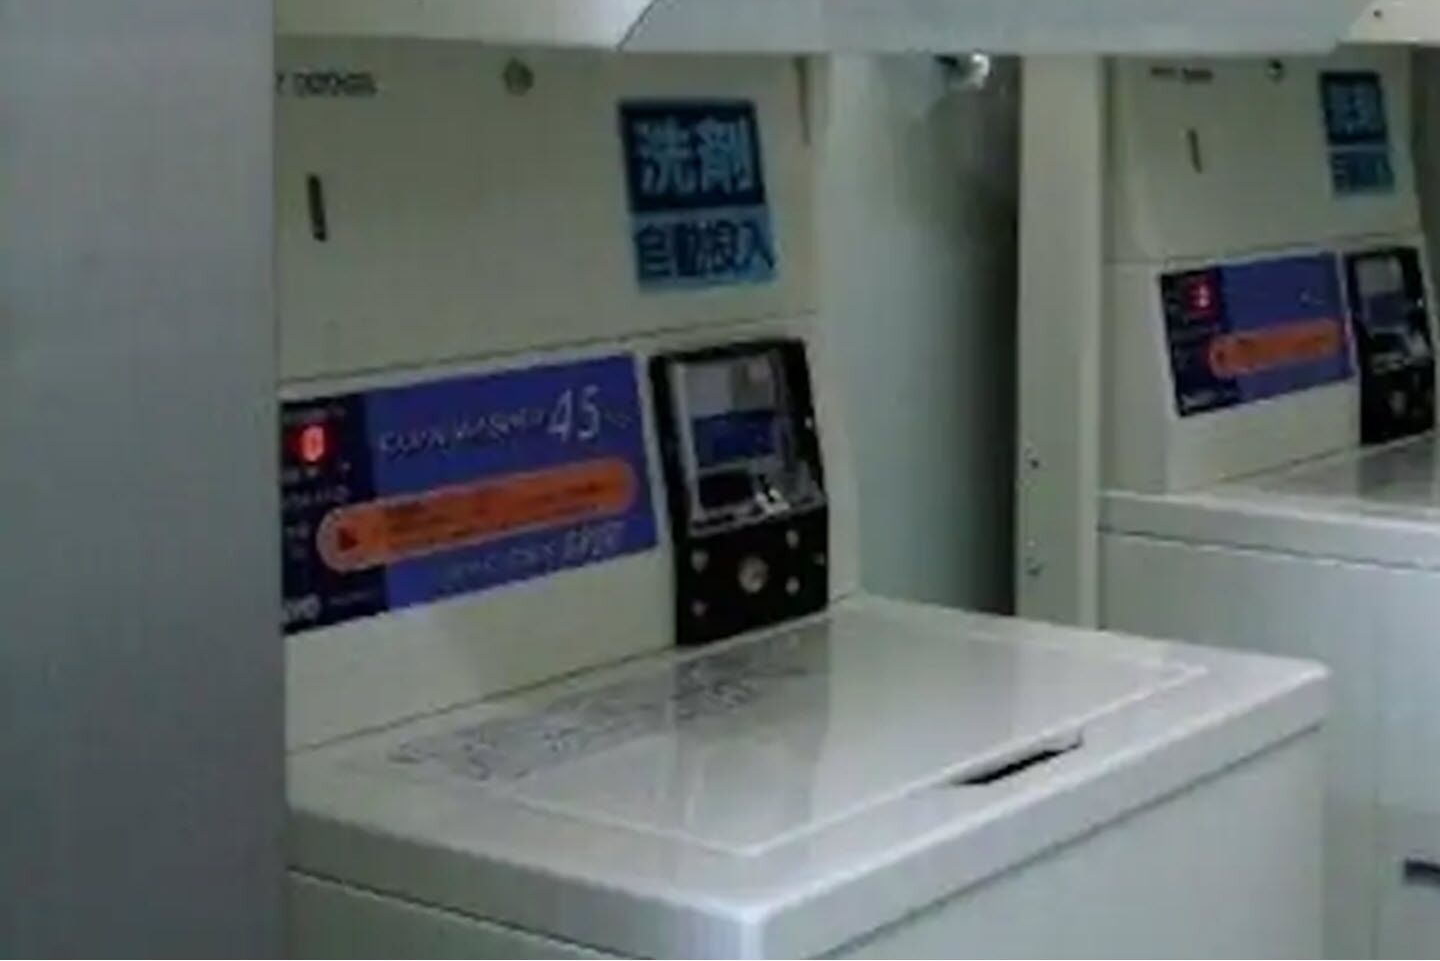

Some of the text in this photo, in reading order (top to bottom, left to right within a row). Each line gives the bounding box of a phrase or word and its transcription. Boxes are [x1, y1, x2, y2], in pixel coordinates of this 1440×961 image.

[632, 115, 754, 195] 洗剤
[635, 220, 775, 278] 自動投入
[547, 383, 602, 443] 45
